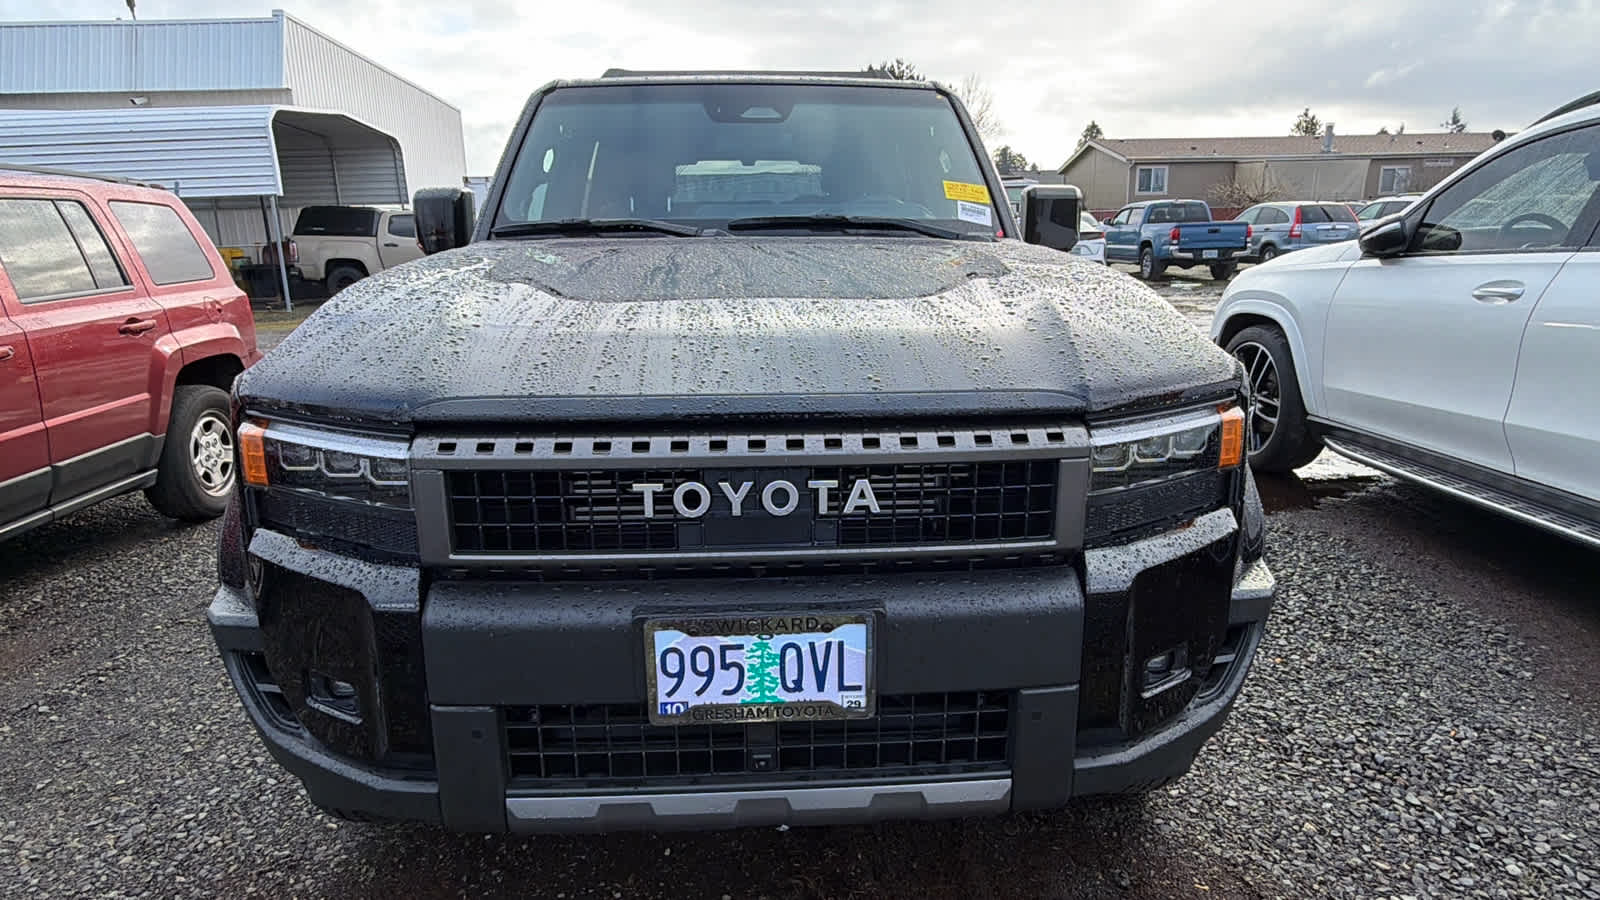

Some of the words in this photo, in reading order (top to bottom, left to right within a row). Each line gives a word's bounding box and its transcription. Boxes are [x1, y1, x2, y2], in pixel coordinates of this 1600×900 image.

[632, 479, 881, 518] TOYOTA
[702, 616, 818, 634] SWICKARD
[660, 643, 745, 698] 995
[779, 639, 863, 693] QVL
[664, 702, 684, 715] 10
[691, 706, 769, 720] GRESHAM
[774, 705, 834, 718] TOYOTA
[846, 699, 862, 710] 29
